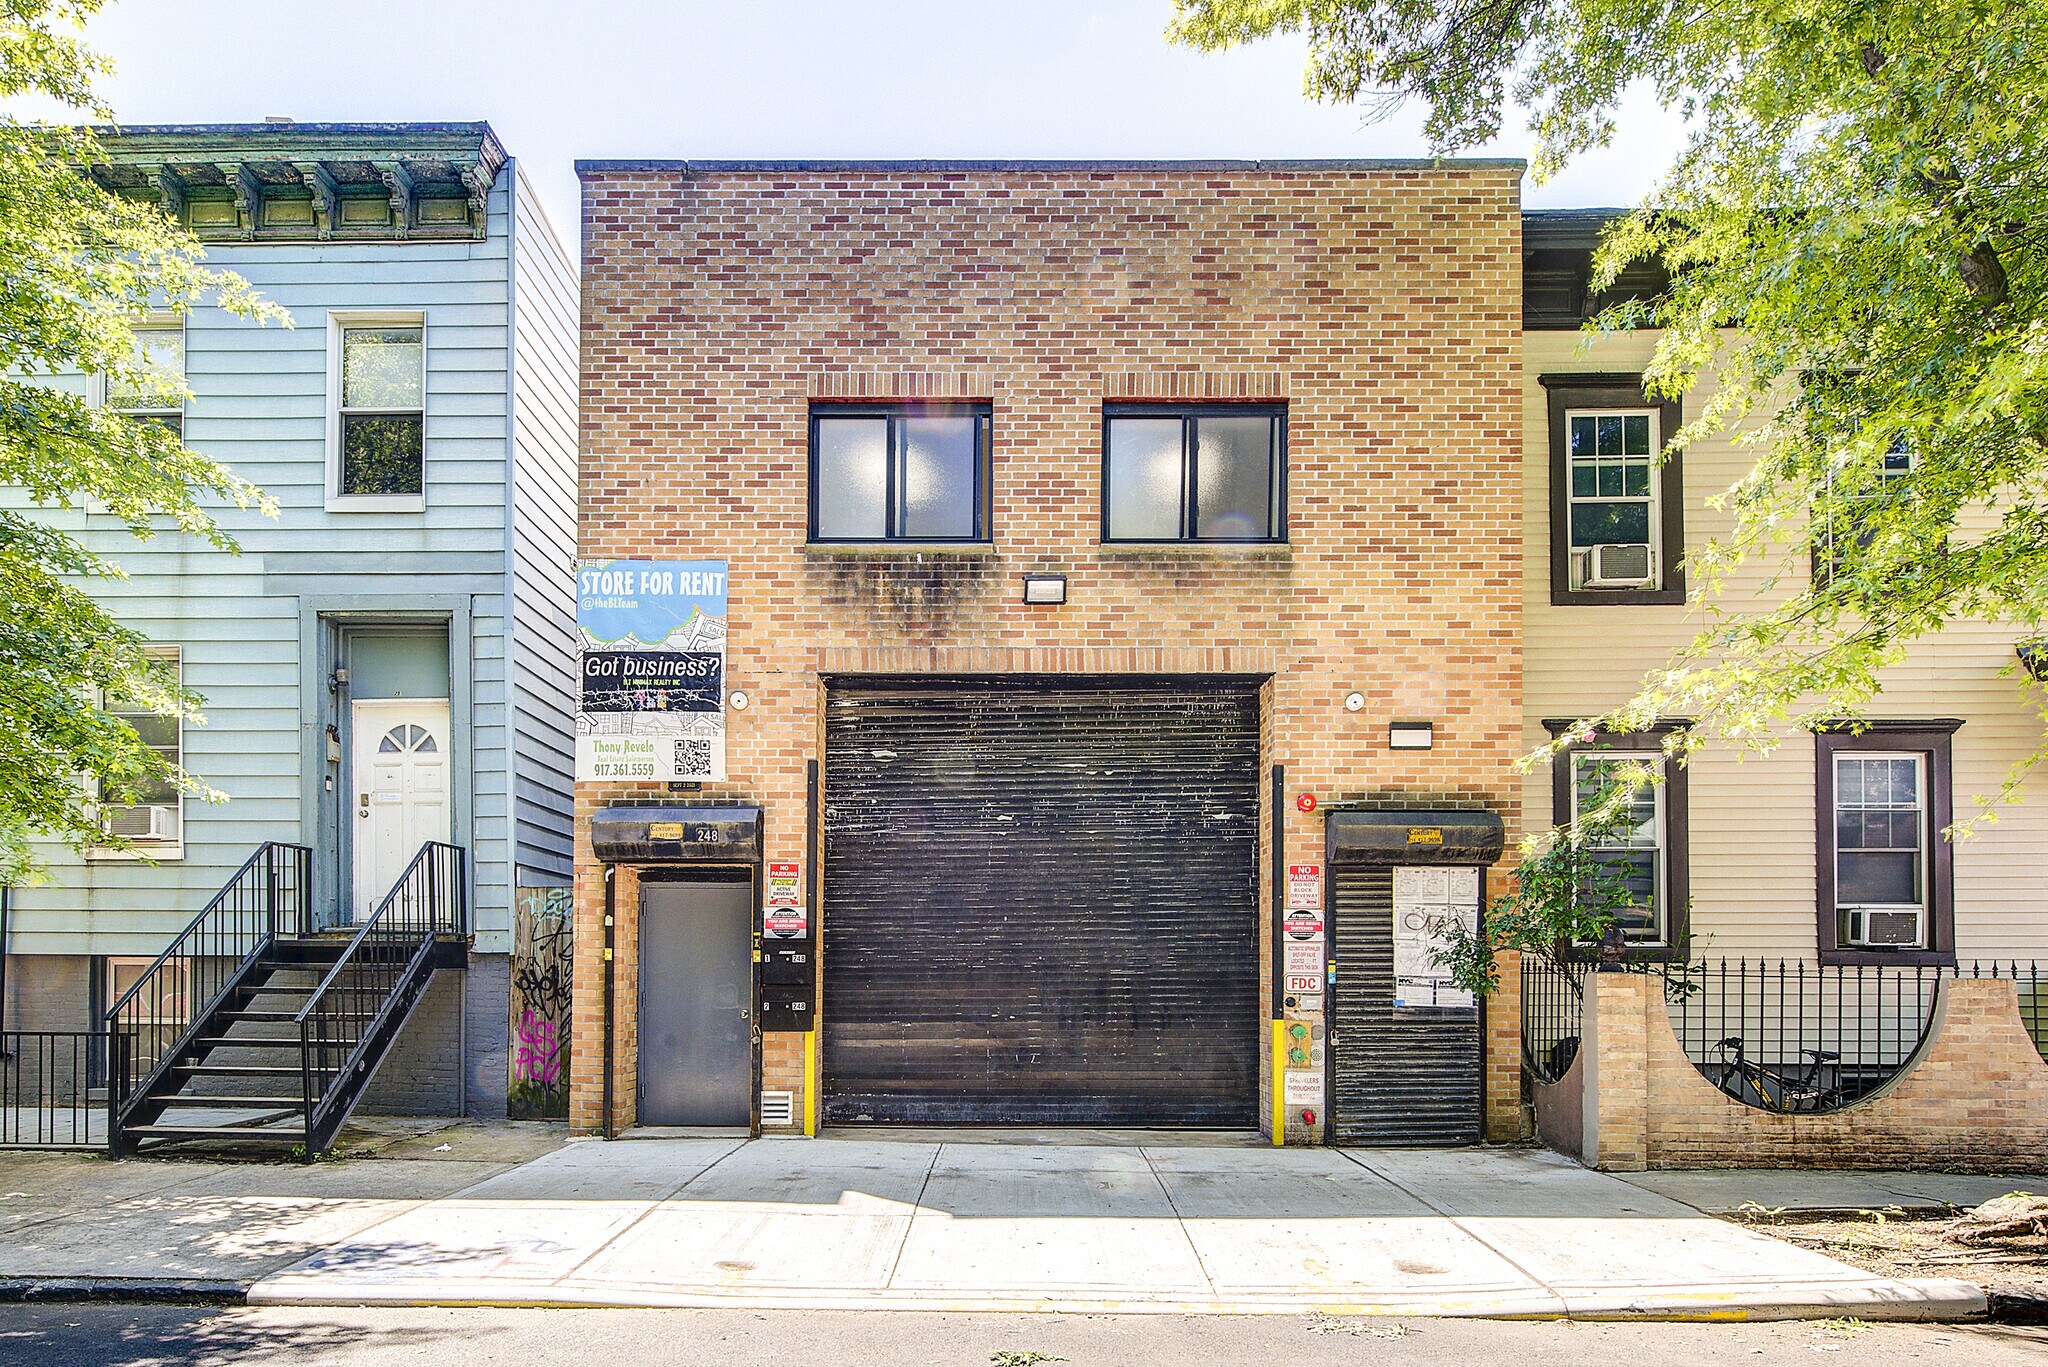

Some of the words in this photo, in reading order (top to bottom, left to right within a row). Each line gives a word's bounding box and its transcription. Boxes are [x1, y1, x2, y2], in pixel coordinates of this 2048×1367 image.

[581, 571, 634, 595] STORE
[640, 571, 674, 595] FOR
[680, 571, 725, 596] RENT
[581, 597, 638, 610] @theBLTeam
[585, 656, 618, 677] Got
[623, 656, 720, 677] business?
[593, 740, 621, 753] Thony
[624, 740, 654, 753] Revelo
[594, 763, 654, 776] 917.361.5559
[698, 830, 718, 841] 248
[1298, 866, 1311, 874] NO
[1291, 977, 1316, 989] FDC
